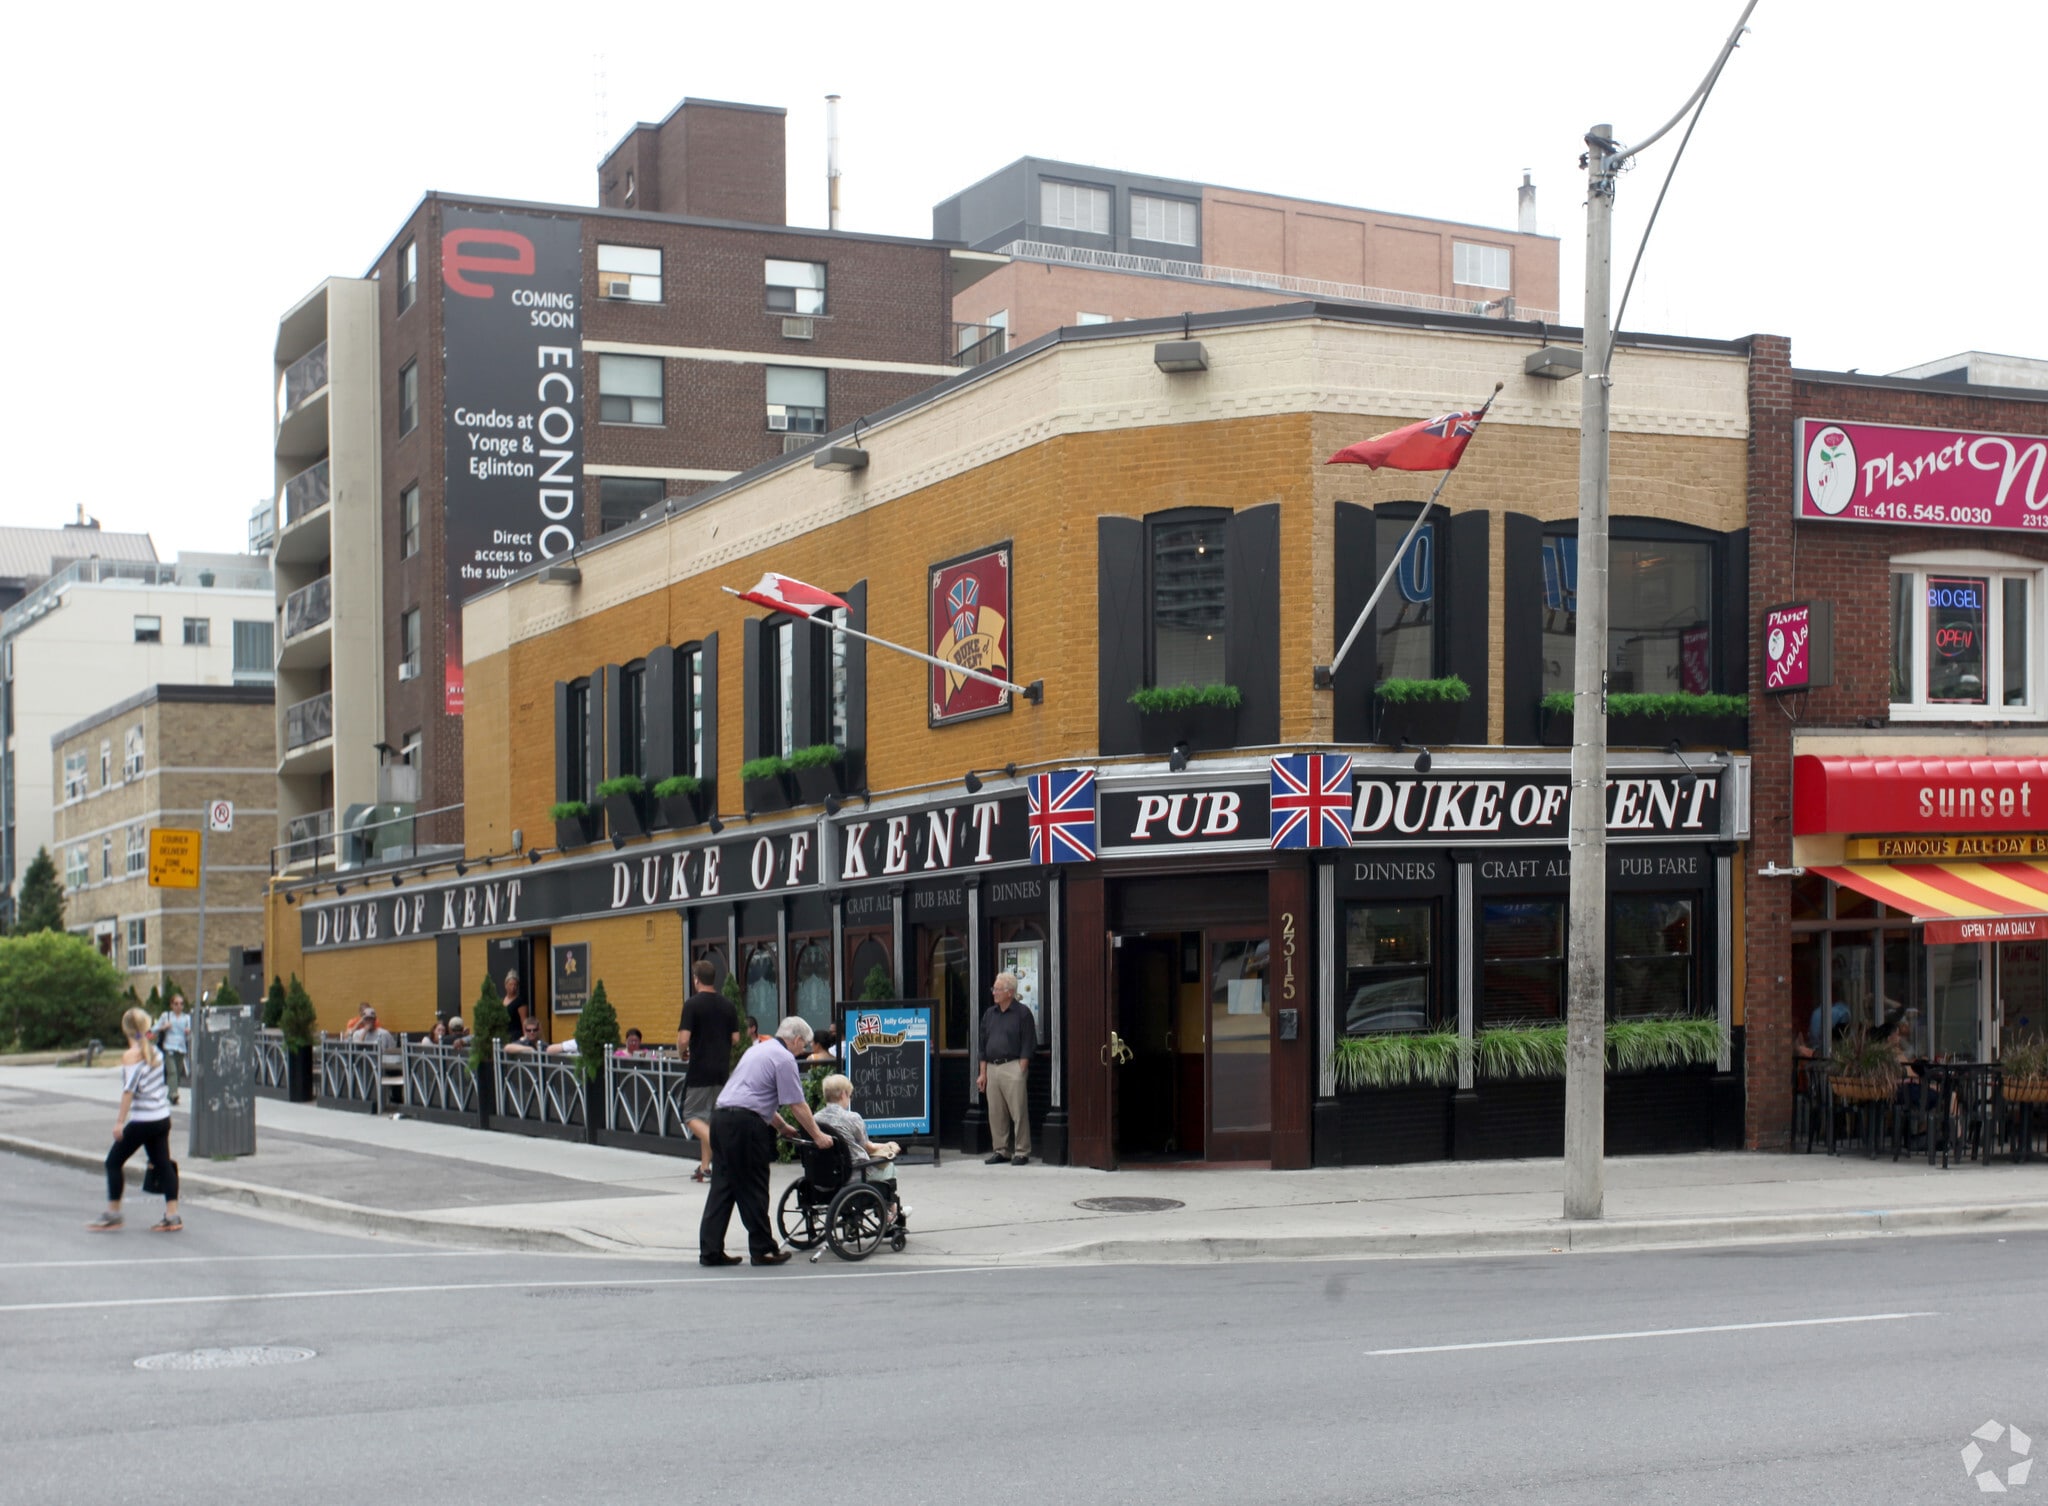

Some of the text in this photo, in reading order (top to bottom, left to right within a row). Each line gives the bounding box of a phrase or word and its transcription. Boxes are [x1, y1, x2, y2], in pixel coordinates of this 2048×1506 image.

[511, 289, 575, 310] COMING
[531, 310, 575, 328] SOON
[454, 408, 534, 430] Condos at
[468, 432, 534, 457] Yonge &
[469, 457, 534, 480] Eglinton
[1862, 437, 1967, 497] Planet
[1853, 502, 1992, 524] TEL: 416.545.0030
[493, 530, 533, 545] Direct
[475, 549, 533, 563] access to
[461, 564, 482, 579] the
[1768, 608, 1808, 626] Planet
[1935, 629, 1973, 649] OPEN
[953, 638, 981, 663] DUKE
[1768, 624, 1808, 688] Nails
[1352, 777, 1717, 833] DUKE OF ENT
[1919, 782, 2031, 817] sunset
[1131, 791, 1241, 839] PUB
[161, 835, 188, 844] COURIER
[1883, 839, 1951, 855] FAMOUS
[159, 846, 188, 855] DELIVERY
[612, 800, 1001, 909] DUKE OF KENT
[165, 858, 180, 867] ZONE
[1354, 862, 1436, 880] DINNERS
[1481, 859, 1571, 879] CRAFT AL
[1619, 857, 1698, 875] PUB FARE
[914, 888, 962, 908] PUB FARE
[992, 879, 1042, 902] DINNERS
[316, 879, 522, 946] DUKE OF KENT
[847, 894, 892, 915] CRAFT ALE
[1961, 921, 2036, 937] OPEN 7 AM DAILY
[1281, 913, 1296, 999] 2315
[884, 1017, 897, 1026] Jolly
[898, 1016, 913, 1025] Good
[883, 1034, 901, 1044] KENT
[854, 1067, 919, 1084] COME INSIDE
[853, 1083, 919, 1098] FOR A FROSTY
